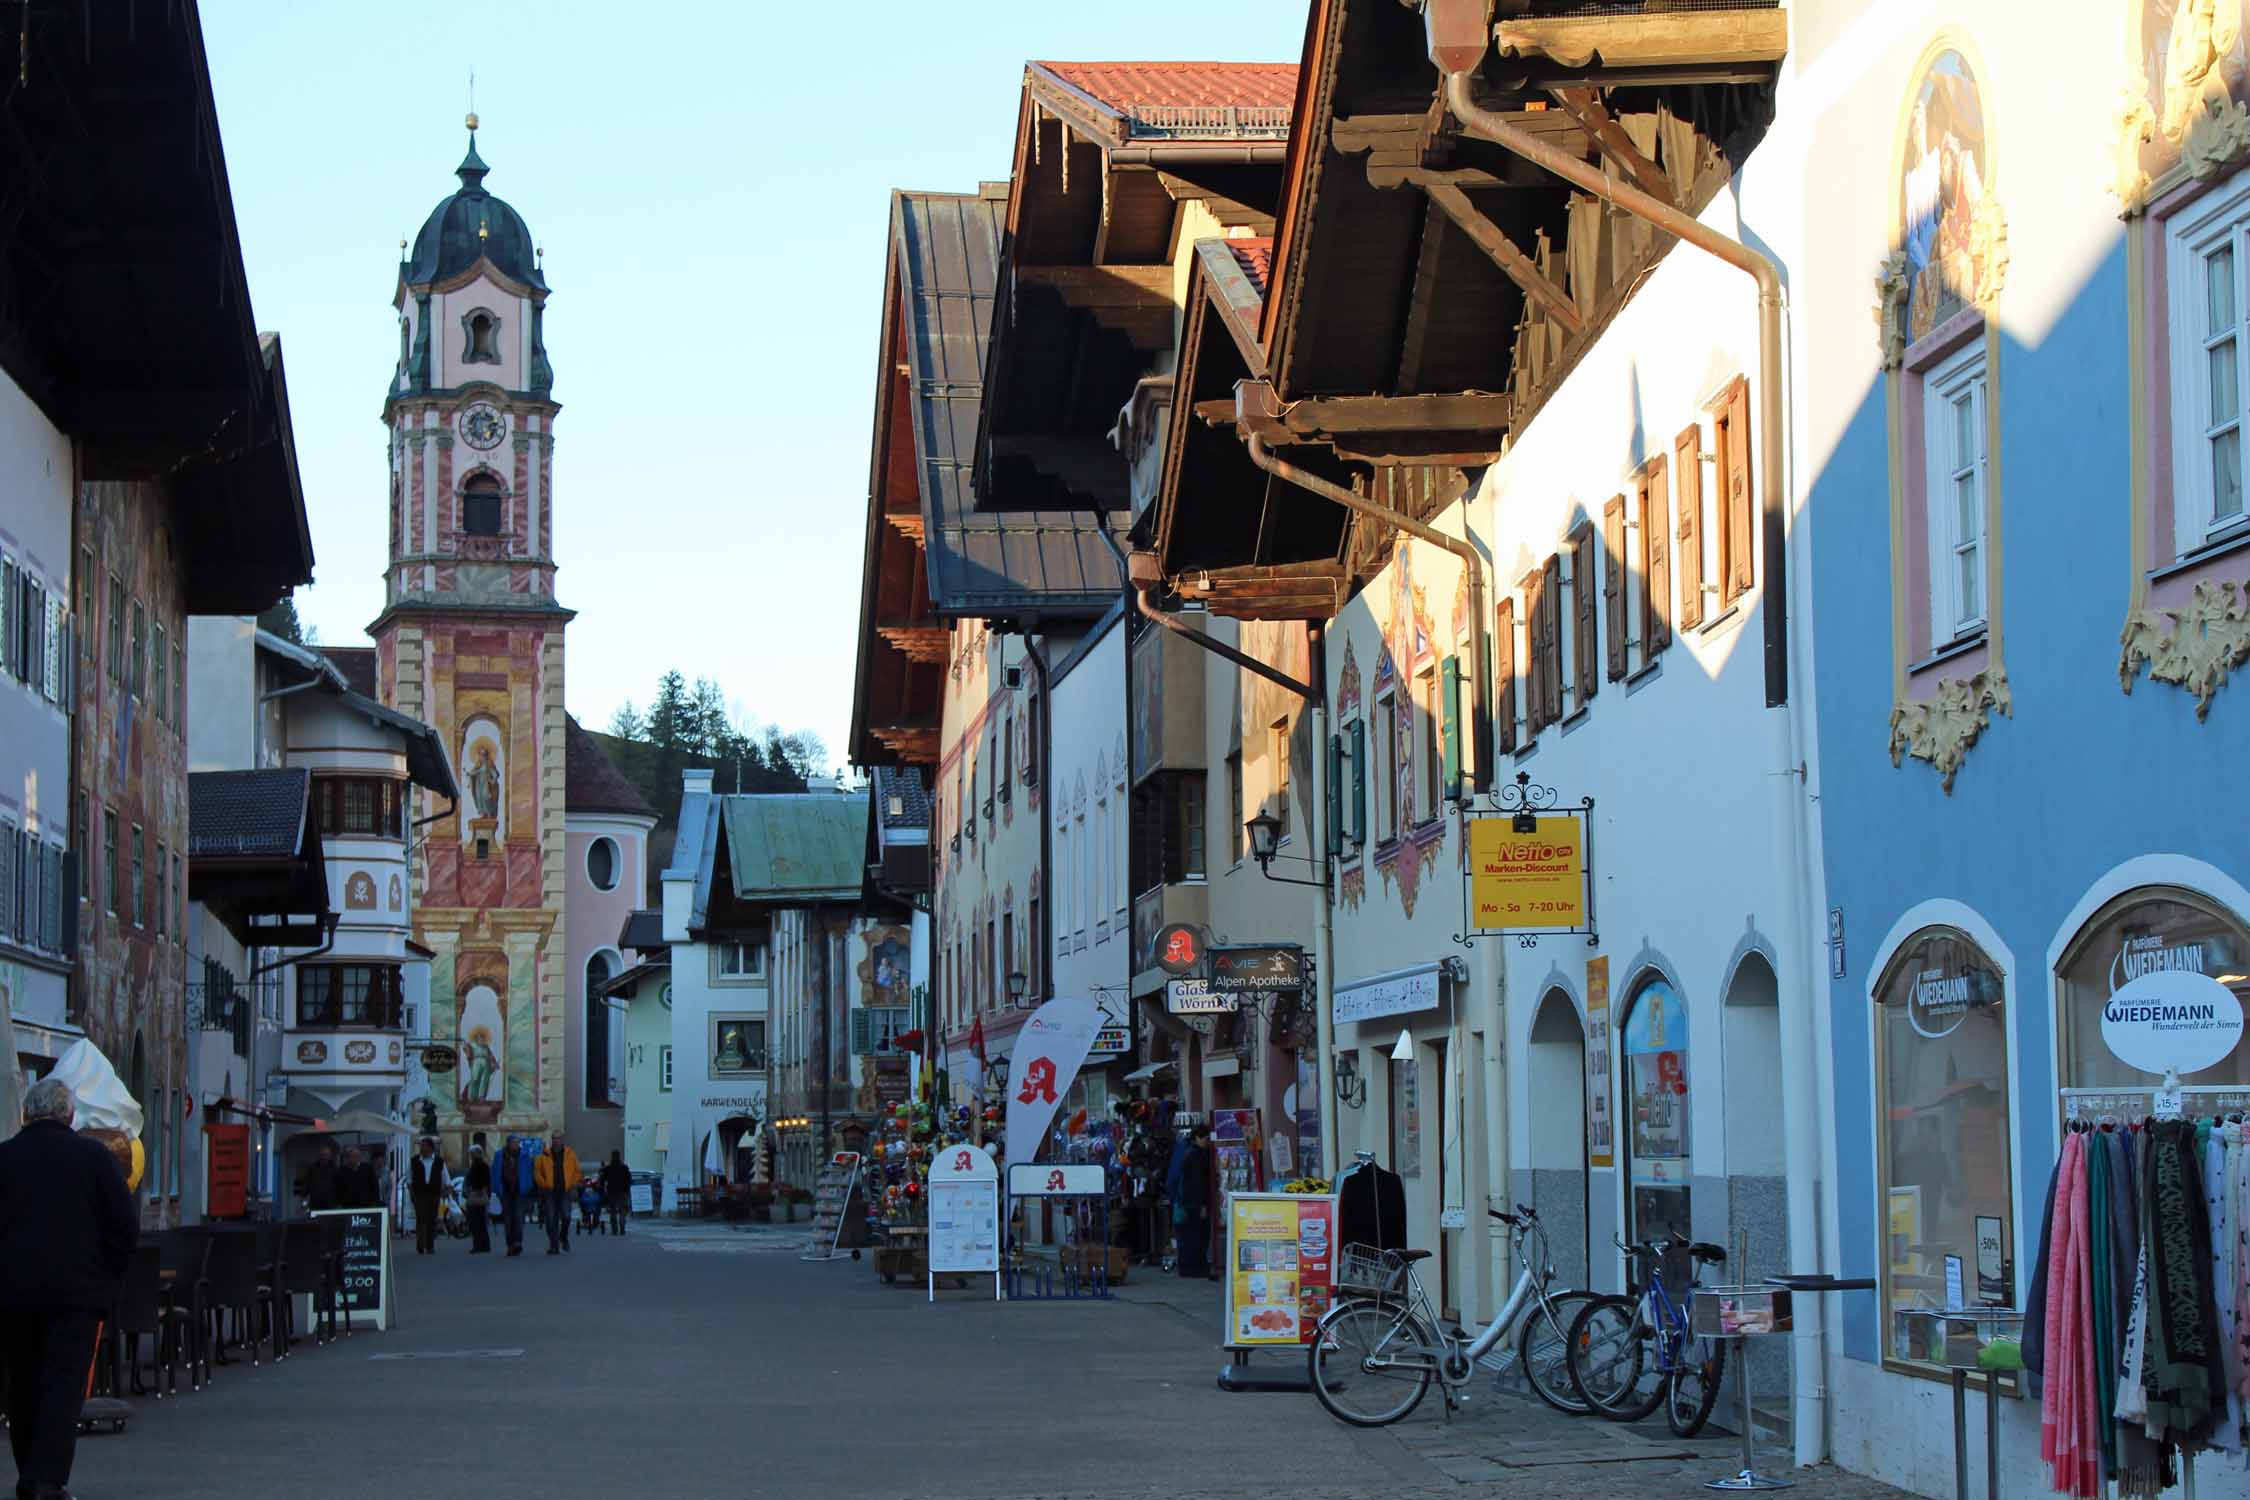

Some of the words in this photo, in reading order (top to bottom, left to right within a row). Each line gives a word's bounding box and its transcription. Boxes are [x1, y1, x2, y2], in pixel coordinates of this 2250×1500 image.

[1499, 841, 1554, 861] Netto
[1484, 863, 1569, 873] Marken-Discount
[1481, 903, 1498, 913] Mo
[1507, 903, 1521, 913] Sa
[1557, 901, 1575, 912] Uhr
[1215, 976, 1246, 989] Alpen
[1249, 974, 1299, 988] Apotheke
[2104, 1001, 2214, 1022] WIEDEMANN
[2151, 1021, 2200, 1031] Wunderwelt
[2200, 1020, 2215, 1029] der
[2216, 1019, 2241, 1029] Sinne
